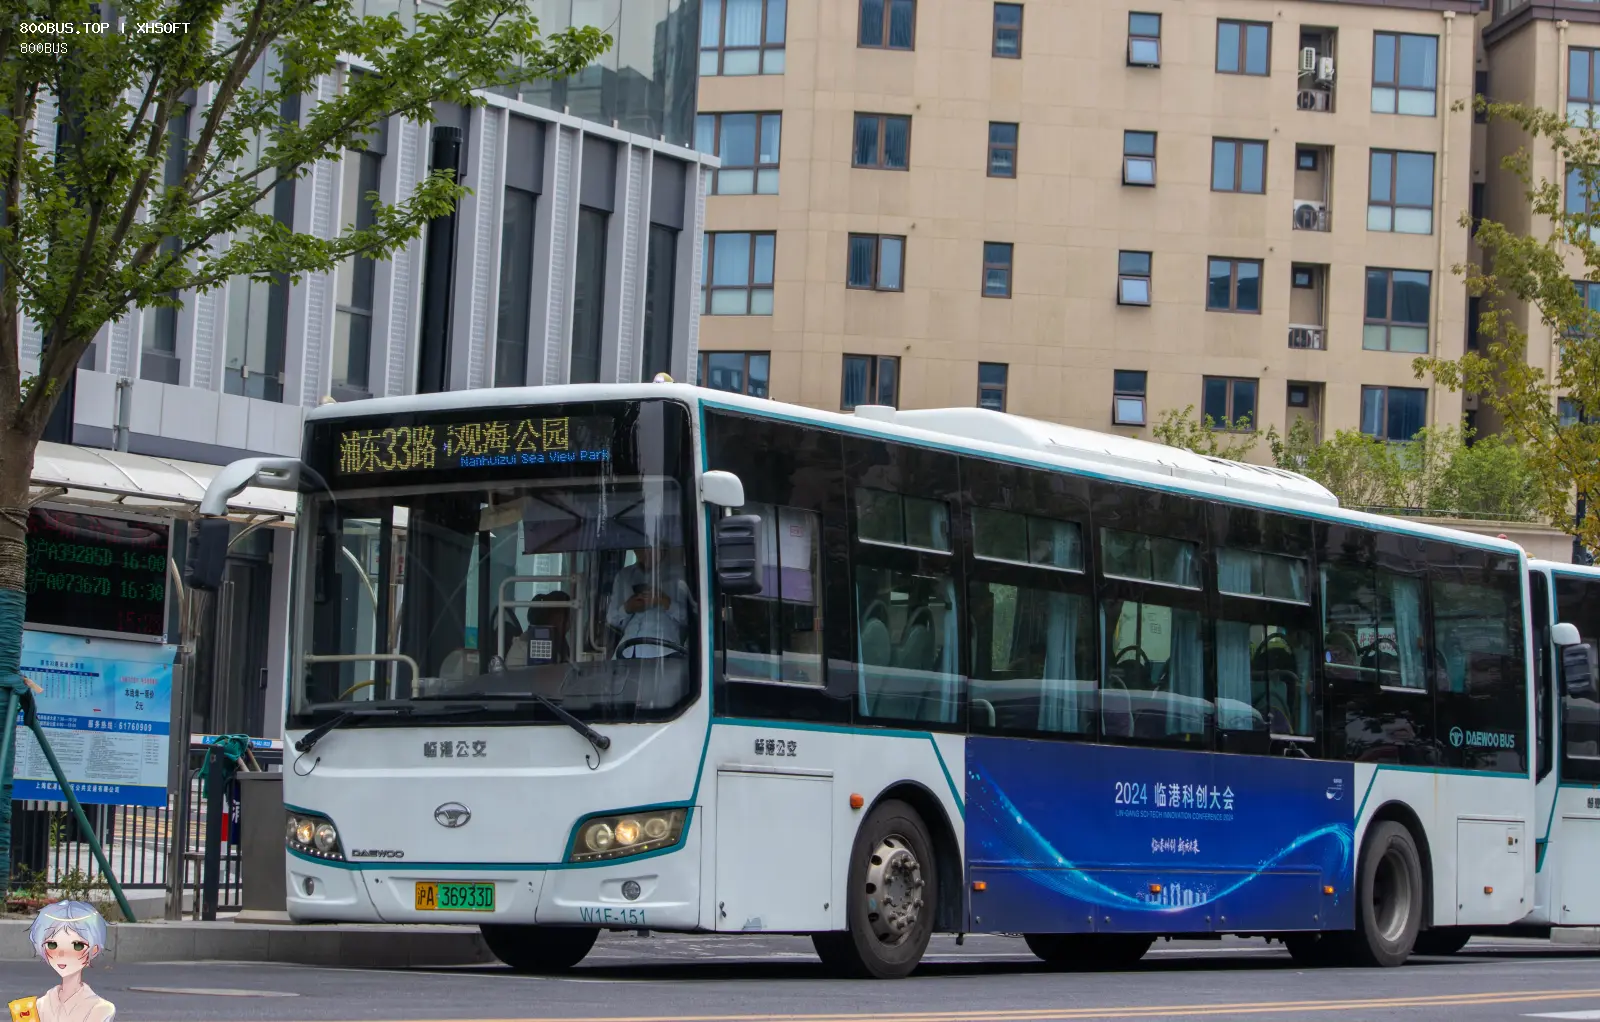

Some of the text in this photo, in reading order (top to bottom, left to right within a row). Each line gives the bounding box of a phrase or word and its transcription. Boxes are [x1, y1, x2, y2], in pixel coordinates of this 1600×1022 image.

[340, 416, 570, 473] 浦东33路 观海公园
[461, 449, 610, 468] Nanhuizui Sea View Park
[122, 551, 166, 573] 16:00
[120, 580, 165, 602] 16:30
[755, 738, 797, 757] 临港公交
[1465, 730, 1515, 748] DAEWOO BUS
[424, 740, 487, 758] 临港公交
[1115, 781, 1235, 811] 2024 临港科创大会
[1163, 811, 1192, 820] INNOVATION
[1192, 812, 1223, 821] CONFERENCE
[351, 849, 405, 859] DAEWOO
